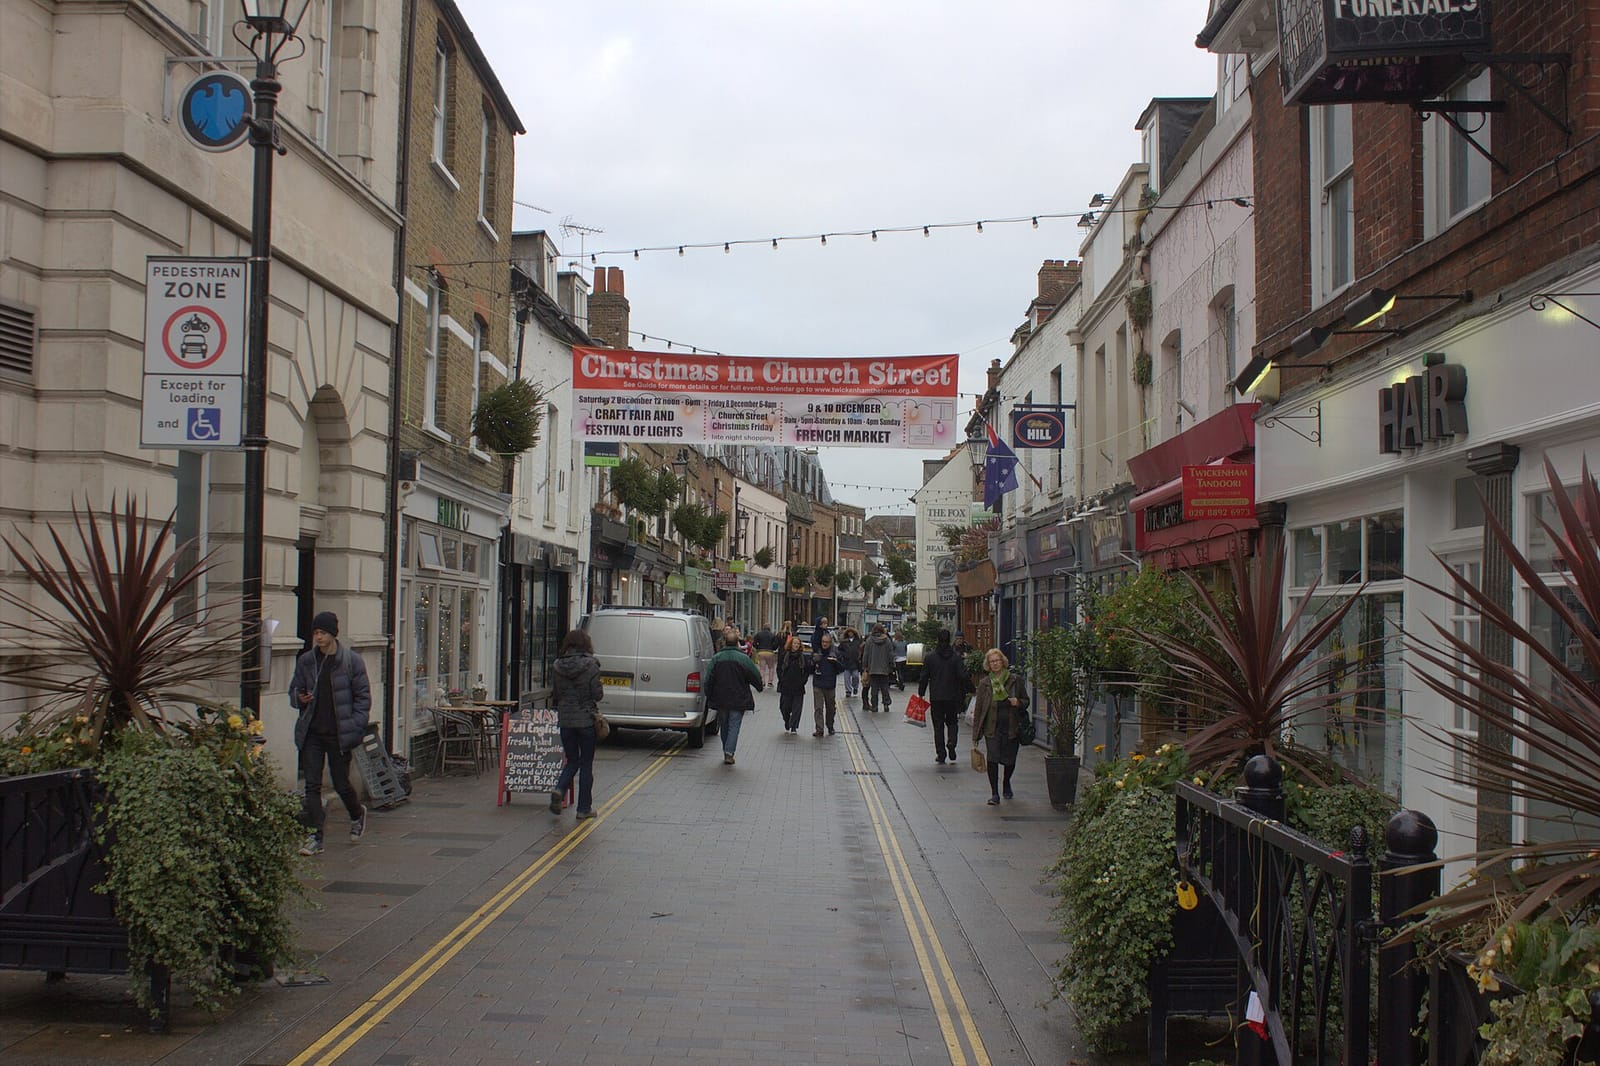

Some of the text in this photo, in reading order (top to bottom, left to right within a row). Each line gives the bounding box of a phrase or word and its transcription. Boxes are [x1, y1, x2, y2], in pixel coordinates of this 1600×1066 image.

[153, 266, 240, 278] PEDESTRIAN
[165, 282, 226, 298] ZONE
[580, 353, 951, 386] Christmas in Church Street
[160, 379, 226, 391] Except for
[637, 381, 657, 389] Guide
[687, 382, 711, 390] details
[719, 383, 729, 391] for
[730, 383, 742, 391] full
[743, 384, 765, 392] events
[170, 392, 216, 405] loading
[578, 395, 610, 406] Saturday
[611, 396, 616, 404] 2
[617, 396, 653, 405] December
[662, 398, 681, 406] noon
[684, 398, 701, 407] 6pm
[708, 399, 725, 408] Friday
[725, 400, 730, 408] 8
[730, 399, 759, 408] December
[595, 408, 674, 421] CRAFT FAIR AND
[807, 404, 881, 414] 9 & 10 DECEMBER
[718, 411, 768, 421] Church Street
[158, 419, 179, 429] and
[712, 421, 774, 433] Christmas Friday
[815, 417, 841, 426] Saturday
[847, 417, 862, 425] 10am
[866, 417, 879, 426] 4pm
[880, 418, 901, 427] Sunday
[585, 424, 683, 438] FESTIVAL OF LIGHTS
[796, 429, 891, 444] FRENCH MARKET
[1027, 429, 1052, 440] HILL
[724, 434, 743, 442] night
[744, 434, 774, 443] shopping
[1189, 468, 1248, 477] TWICKENHAM
[1196, 478, 1241, 488] TANDOORI
[927, 508, 966, 518] THE FOX
[508, 721, 526, 734] Full
[536, 759, 562, 769] Bread
[504, 775, 531, 785] Jacket
